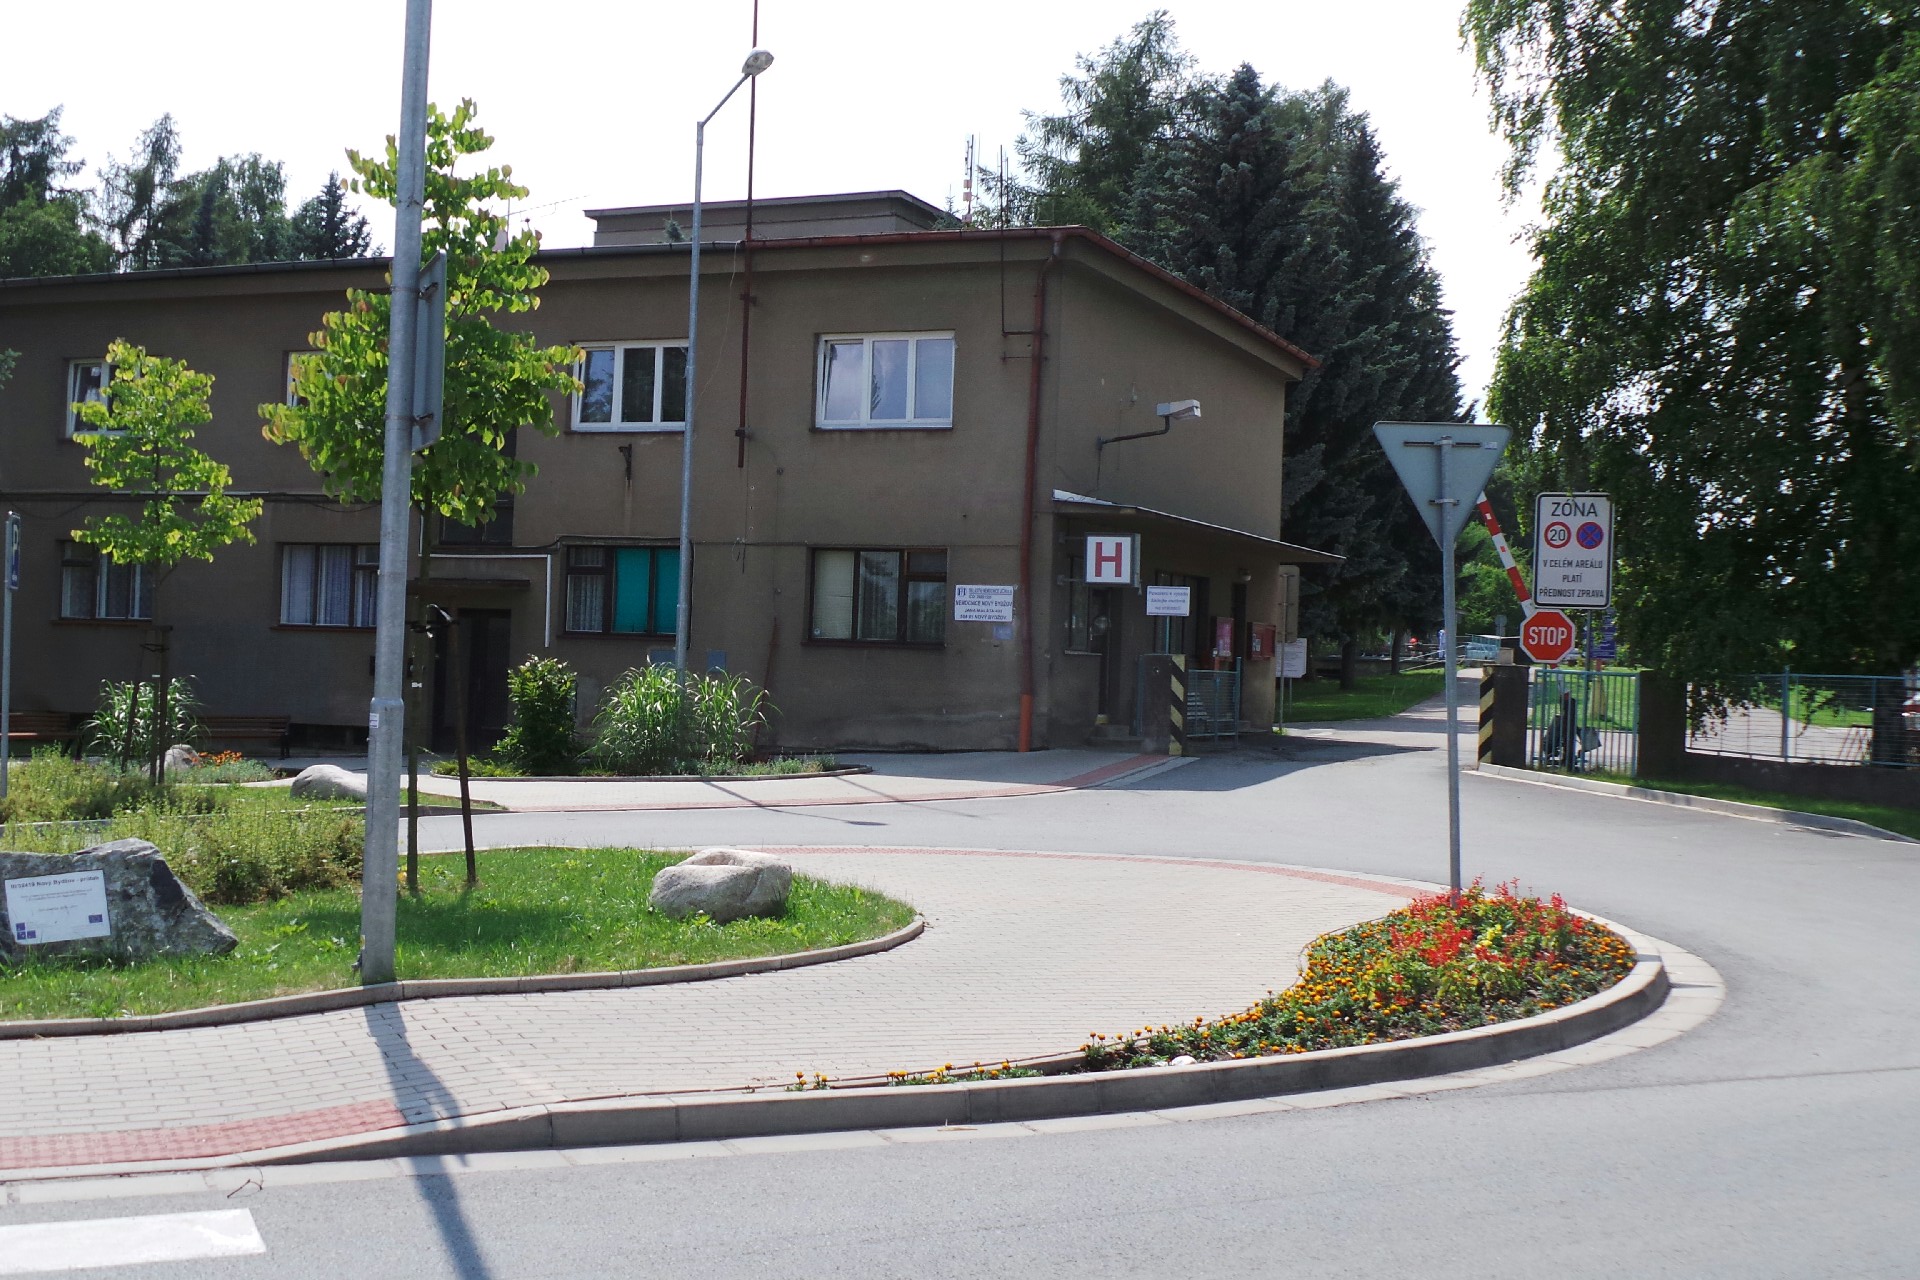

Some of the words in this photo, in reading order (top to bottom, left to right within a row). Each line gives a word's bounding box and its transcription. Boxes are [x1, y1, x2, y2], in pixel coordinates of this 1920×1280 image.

[1551, 499, 1598, 517] ZÓNA
[1549, 529, 1566, 542] 20
[1095, 542, 1122, 577] H
[1543, 560, 1547, 568] V
[1549, 557, 1573, 568] CELÉM
[1575, 558, 1603, 569] AREÁLU
[1562, 573, 1583, 583] PLATÍ
[1539, 587, 1575, 597] PŘEDNOST
[1577, 589, 1604, 598] ZPRAVA
[1528, 626, 1567, 646] STOP
